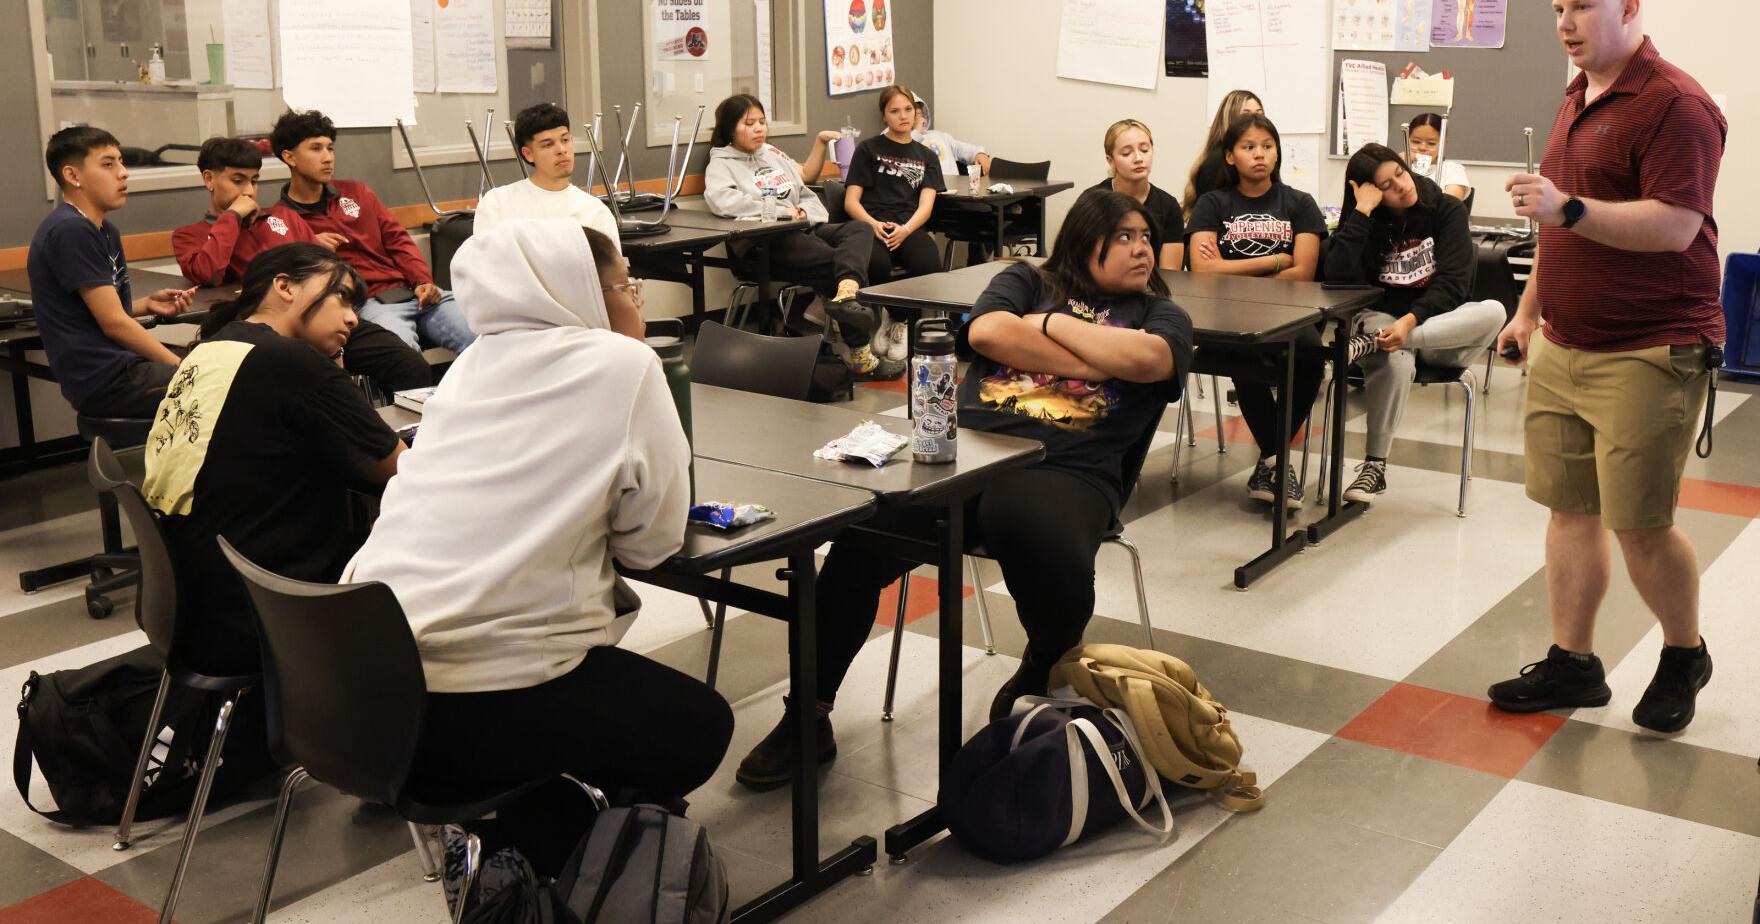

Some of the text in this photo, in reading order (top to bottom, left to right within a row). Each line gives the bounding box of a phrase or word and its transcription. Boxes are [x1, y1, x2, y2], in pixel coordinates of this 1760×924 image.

[661, 9, 701, 21] the Tables
[1223, 220, 1293, 242] TOPPENISH
[1230, 232, 1279, 241] VOLLEYBALL
